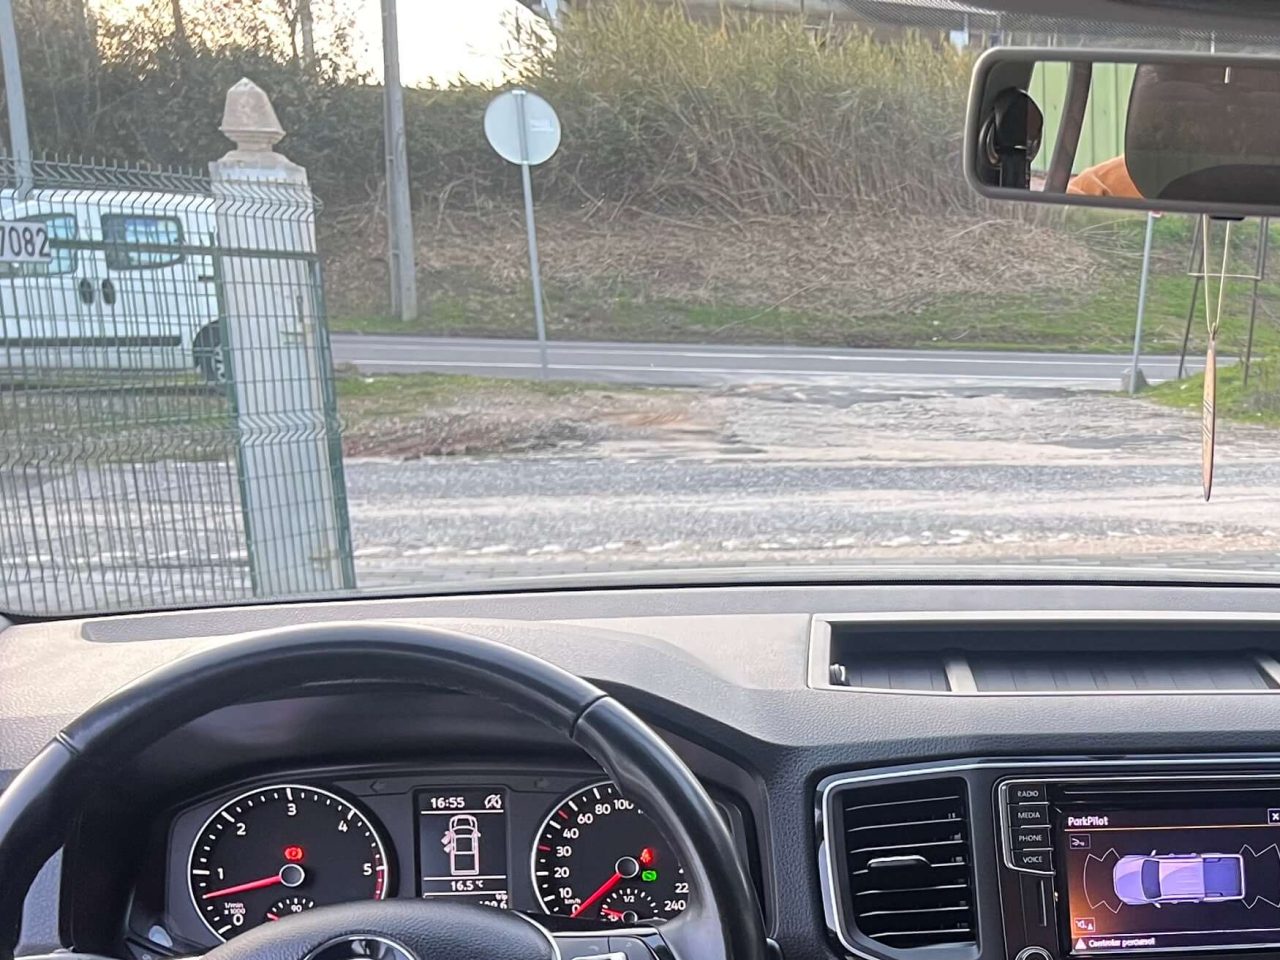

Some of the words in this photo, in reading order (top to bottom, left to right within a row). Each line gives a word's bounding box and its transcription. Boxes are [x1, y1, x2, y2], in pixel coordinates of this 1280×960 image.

[430, 797, 465, 809] 16:55
[595, 803, 611, 814] 80
[287, 803, 297, 815] 3
[577, 813, 593, 824] 60
[1067, 816, 1109, 827] ParkPilot
[236, 823, 246, 836] 2
[338, 821, 348, 833] 4
[562, 828, 579, 839] 40
[1018, 834, 1042, 842] PHONE
[556, 846, 572, 857] 30
[1023, 855, 1043, 863] VOICE
[217, 867, 224, 880] 1
[363, 863, 372, 876] 5
[554, 866, 570, 878] 20
[450, 880, 474, 891] 16.5
[675, 883, 689, 894] 22
[558, 887, 573, 899] 10
[623, 895, 635, 903] 1/2
[291, 904, 302, 914] 90
[664, 899, 686, 911] 240
[233, 914, 244, 926] 0
